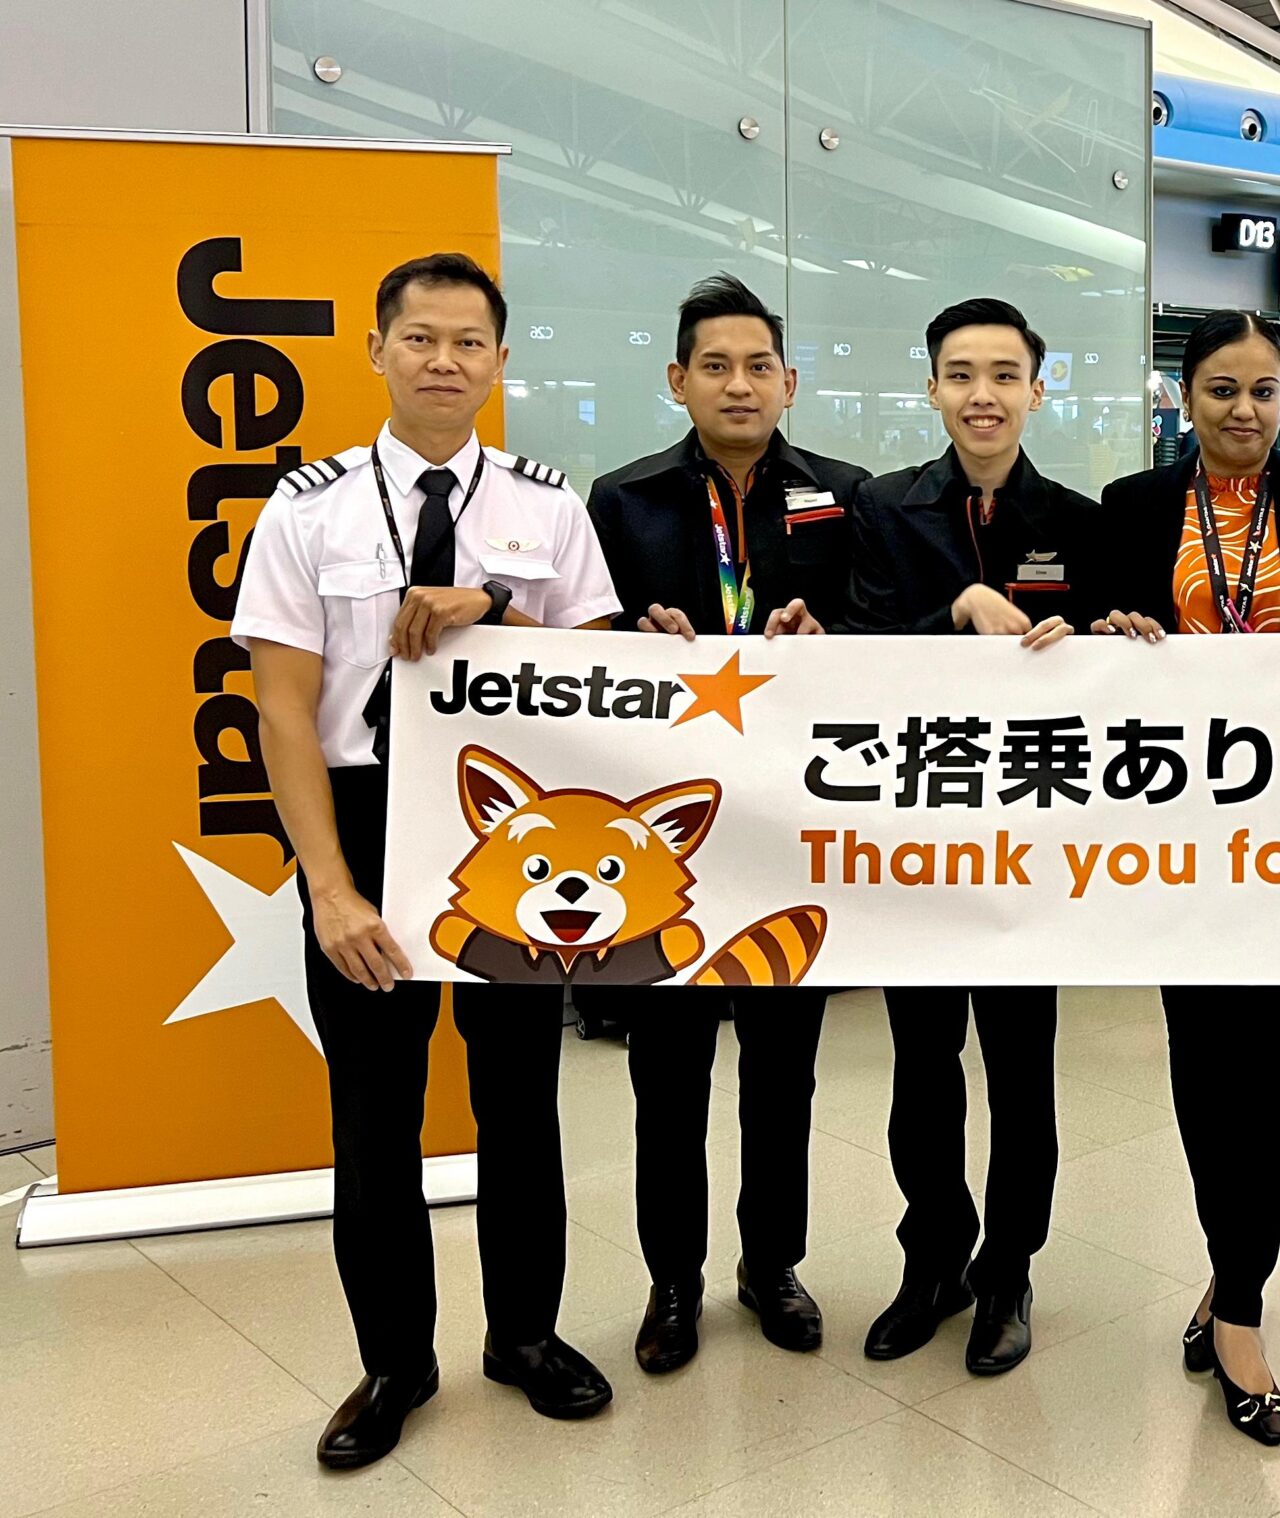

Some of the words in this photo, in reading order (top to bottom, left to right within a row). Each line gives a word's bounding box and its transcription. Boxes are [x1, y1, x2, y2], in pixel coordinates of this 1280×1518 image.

[1239, 218, 1276, 249] D13
[714, 523, 727, 555] Jetstar
[430, 659, 685, 720] Jetstar
[800, 829, 1032, 886] Thank
[1063, 842, 1196, 899] you
